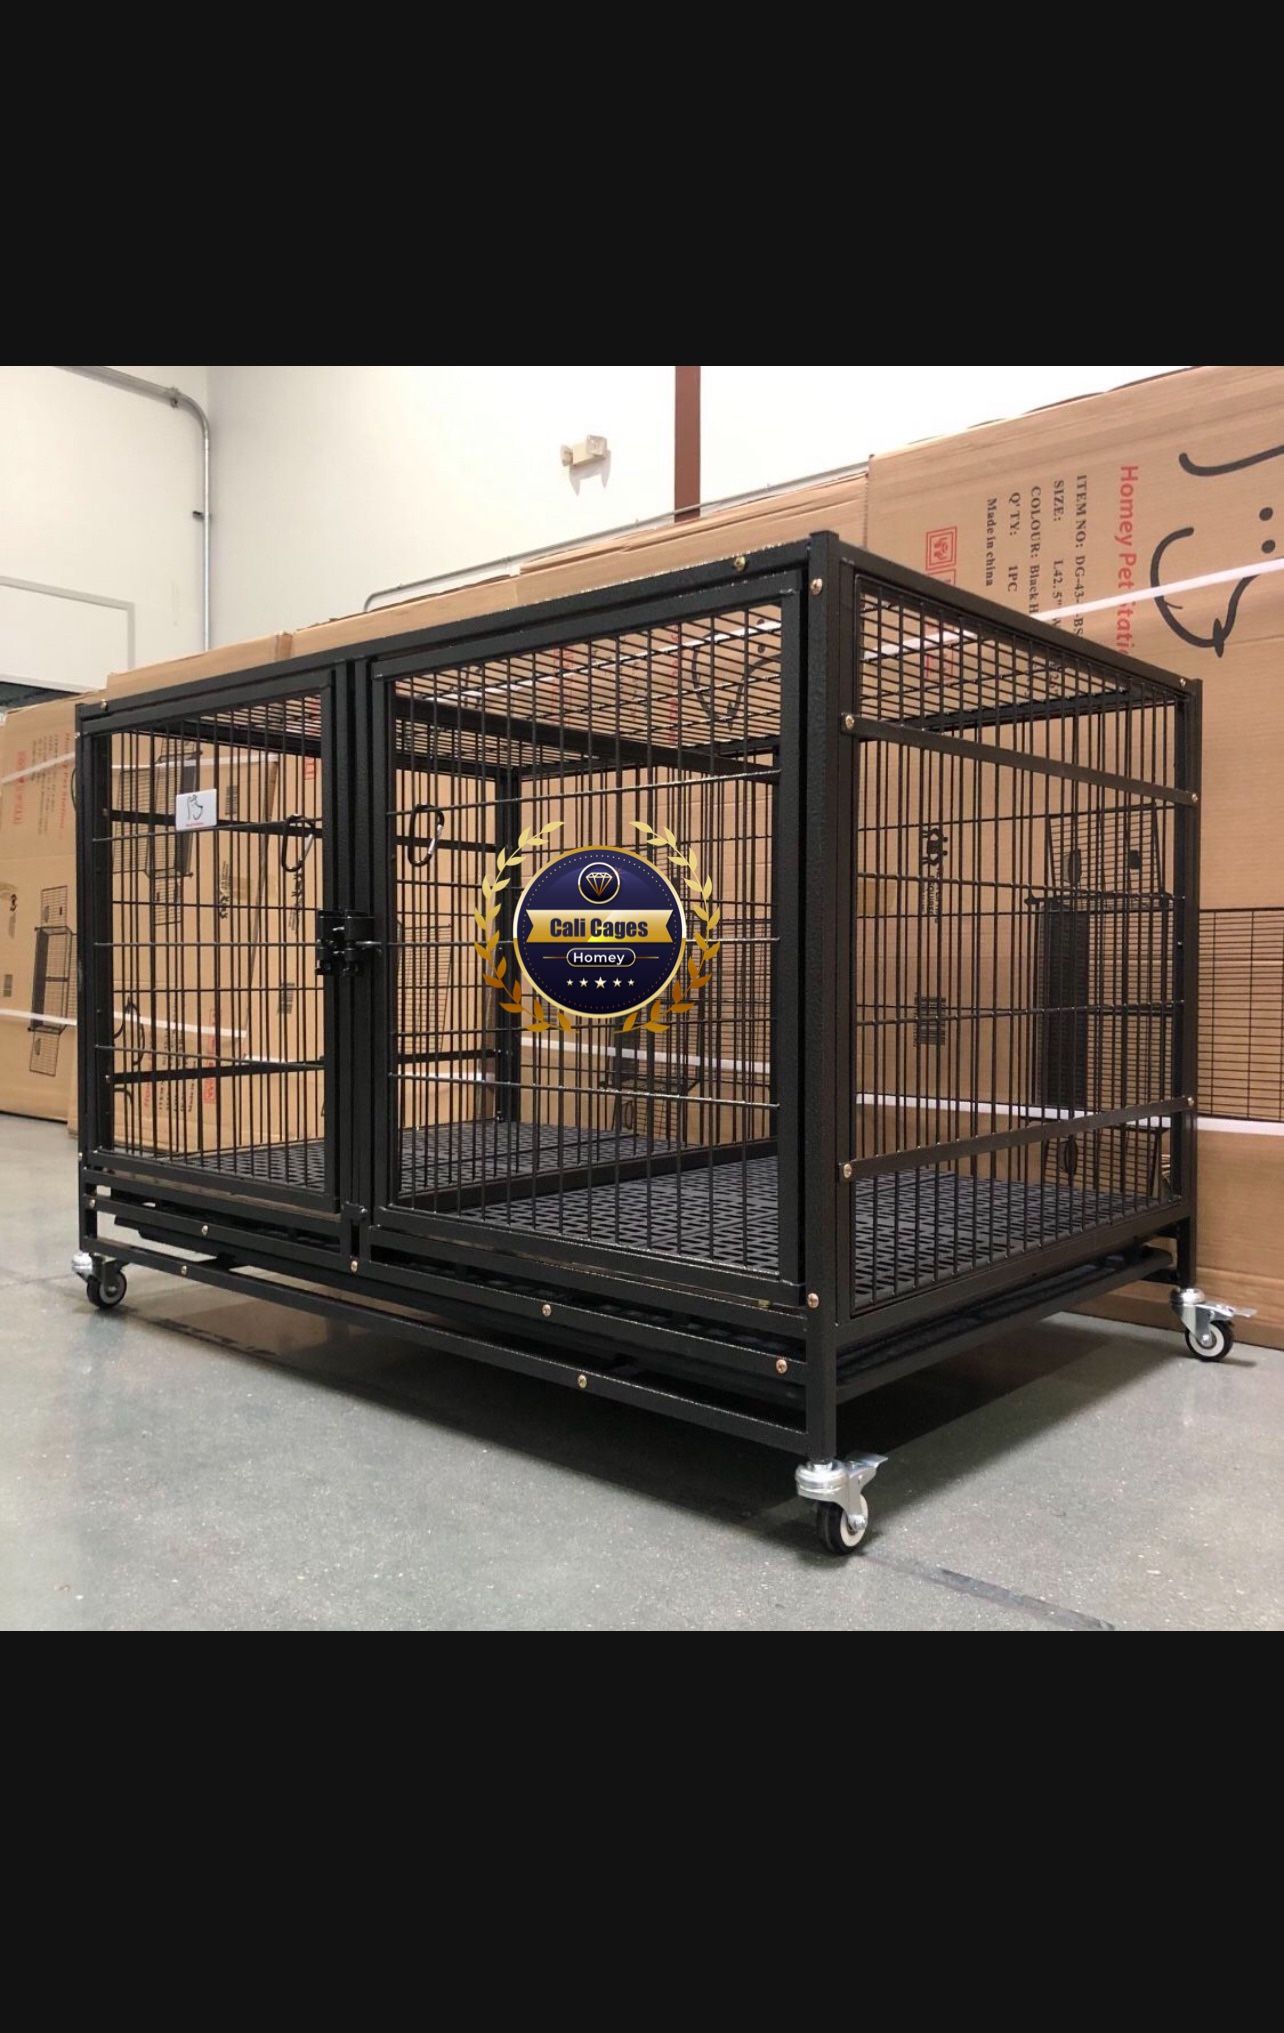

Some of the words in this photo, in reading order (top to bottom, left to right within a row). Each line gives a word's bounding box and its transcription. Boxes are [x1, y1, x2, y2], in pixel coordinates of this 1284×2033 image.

[1053, 480, 1065, 522] SIZE:
[1075, 474, 1088, 517] ITEM
[1114, 466, 1139, 547] Homey
[1030, 486, 1042, 559] COLOUR:
[1075, 520, 1087, 548] NO:
[985, 551, 996, 587] china
[1008, 565, 1019, 592] 1PC
[1117, 553, 1138, 589] Pet
[1115, 601, 1136, 655] tati
